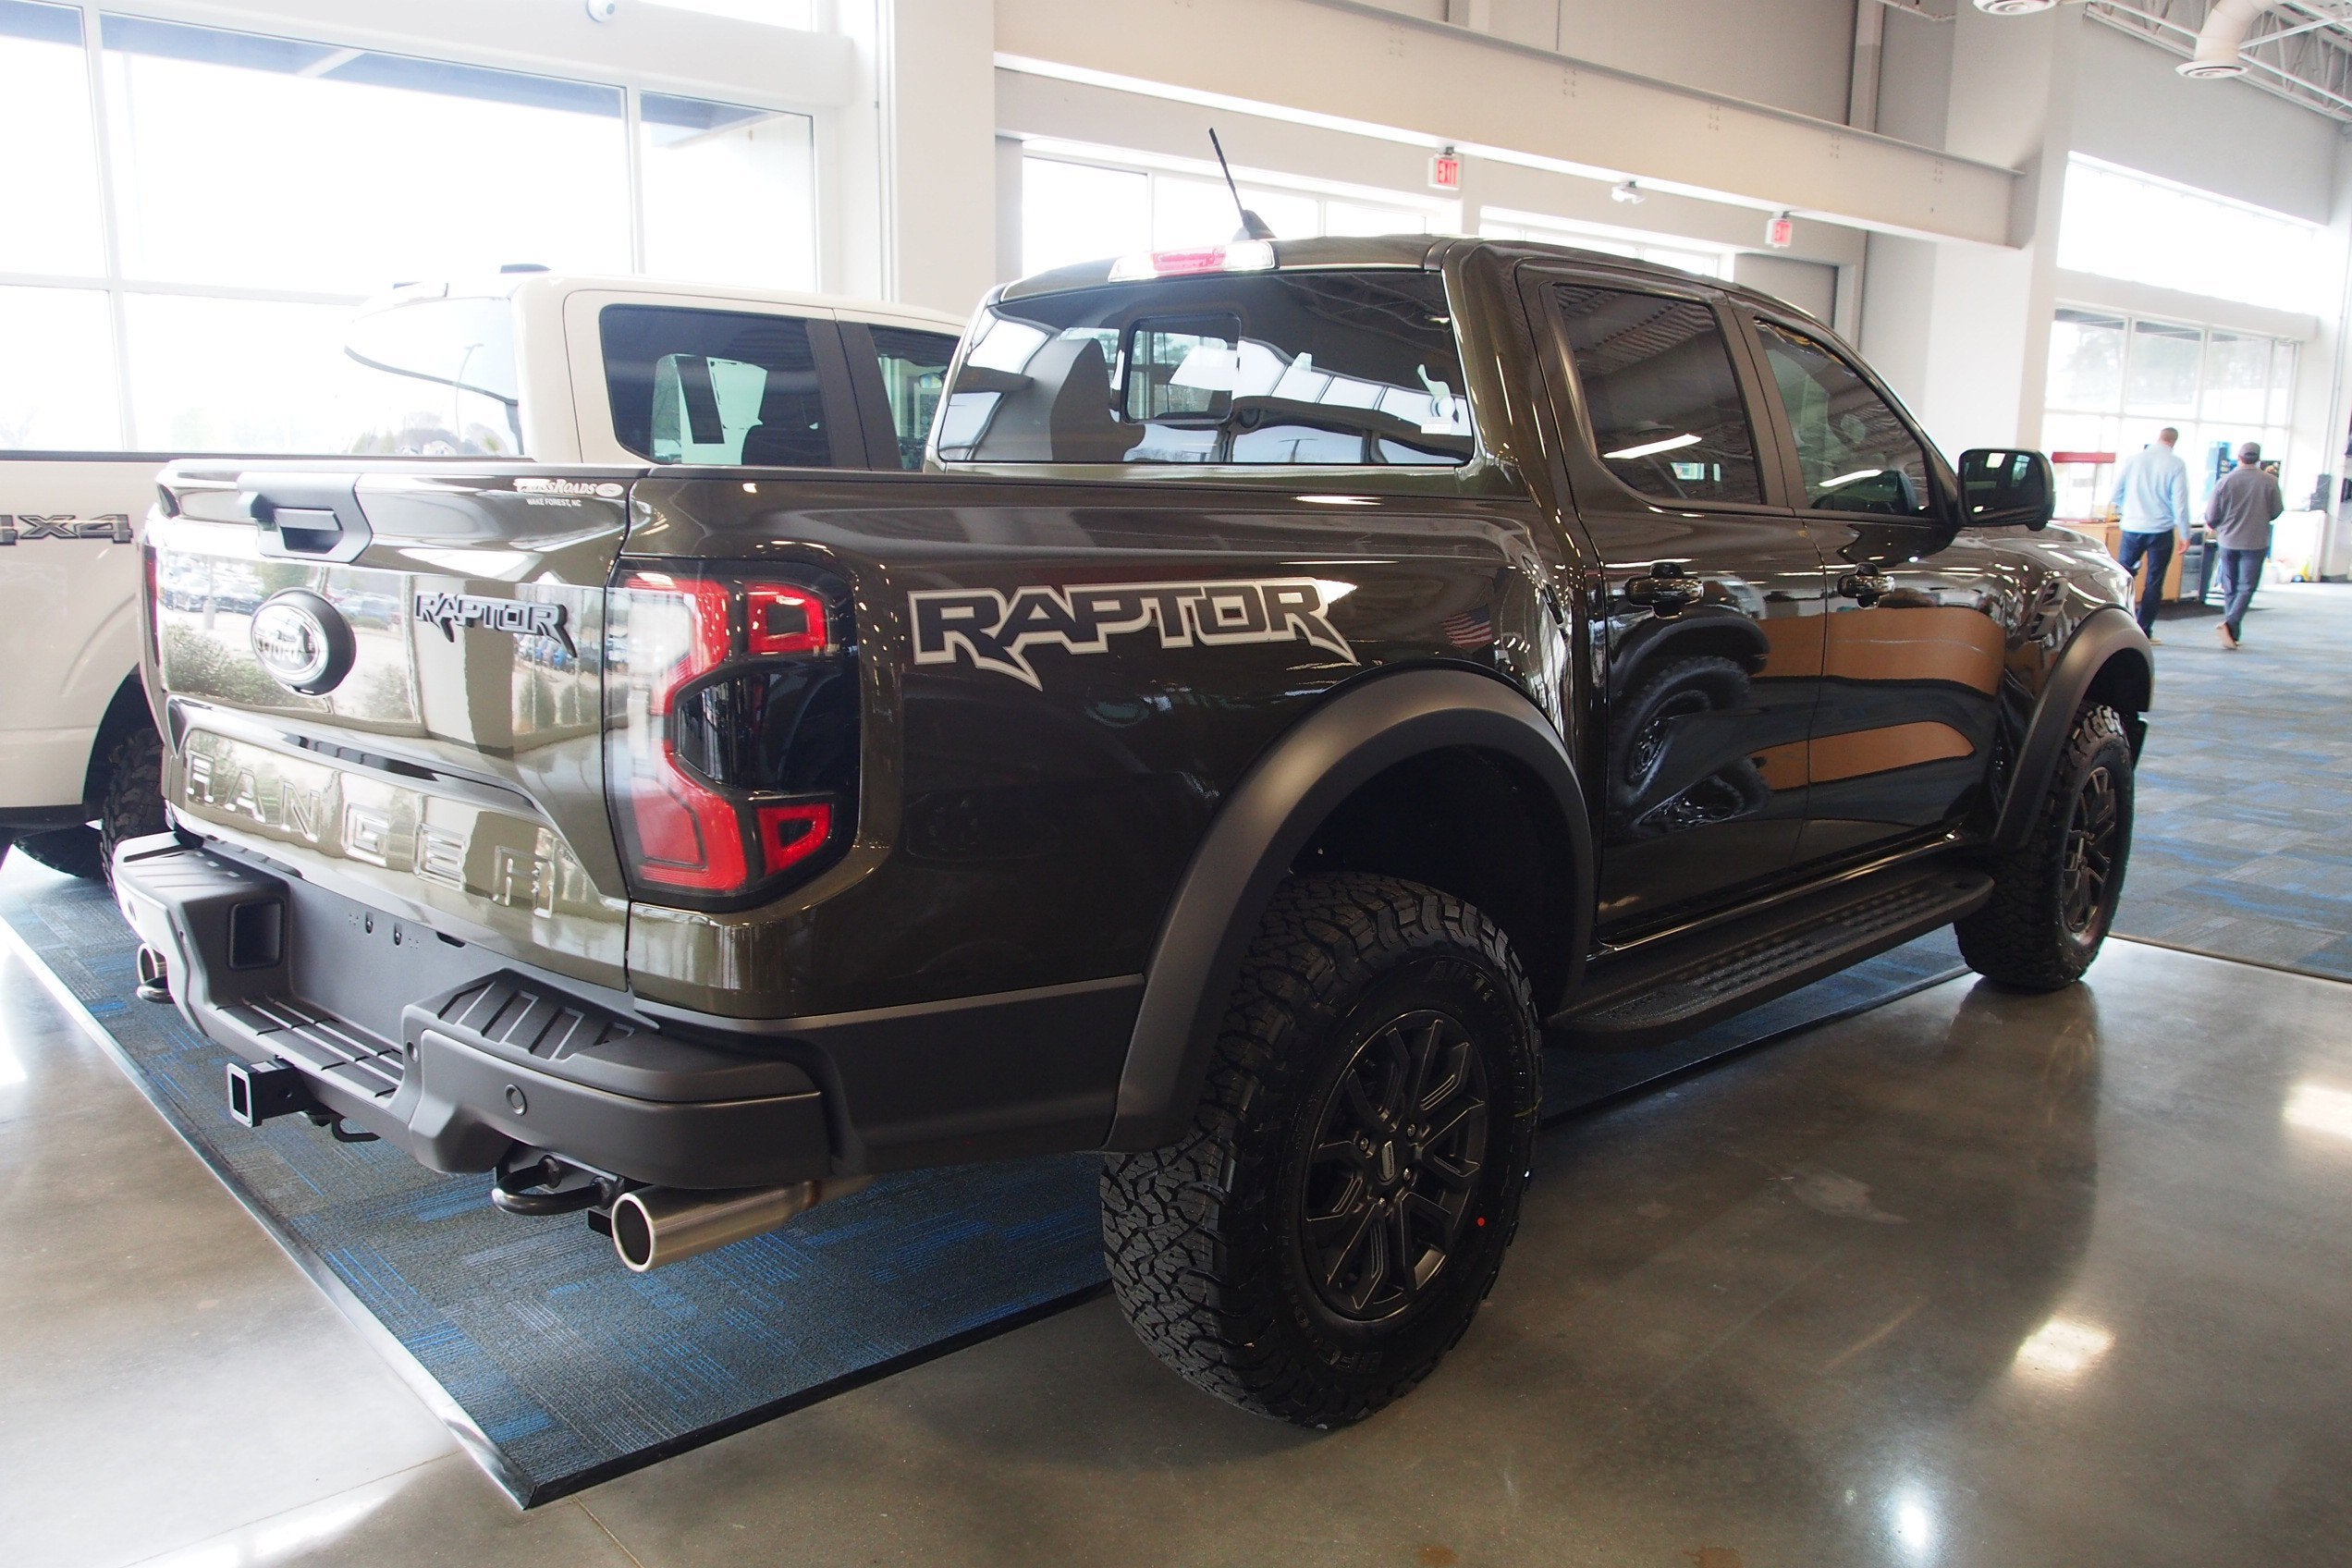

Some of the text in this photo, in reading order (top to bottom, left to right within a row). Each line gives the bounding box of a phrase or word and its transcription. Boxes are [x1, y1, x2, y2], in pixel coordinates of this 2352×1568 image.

[1437, 160, 1458, 185] EXIT
[572, 499, 582, 508] NC
[415, 592, 578, 658] RAPTOR
[908, 577, 1359, 691] RAPTOR
[185, 750, 555, 920] RANGER
